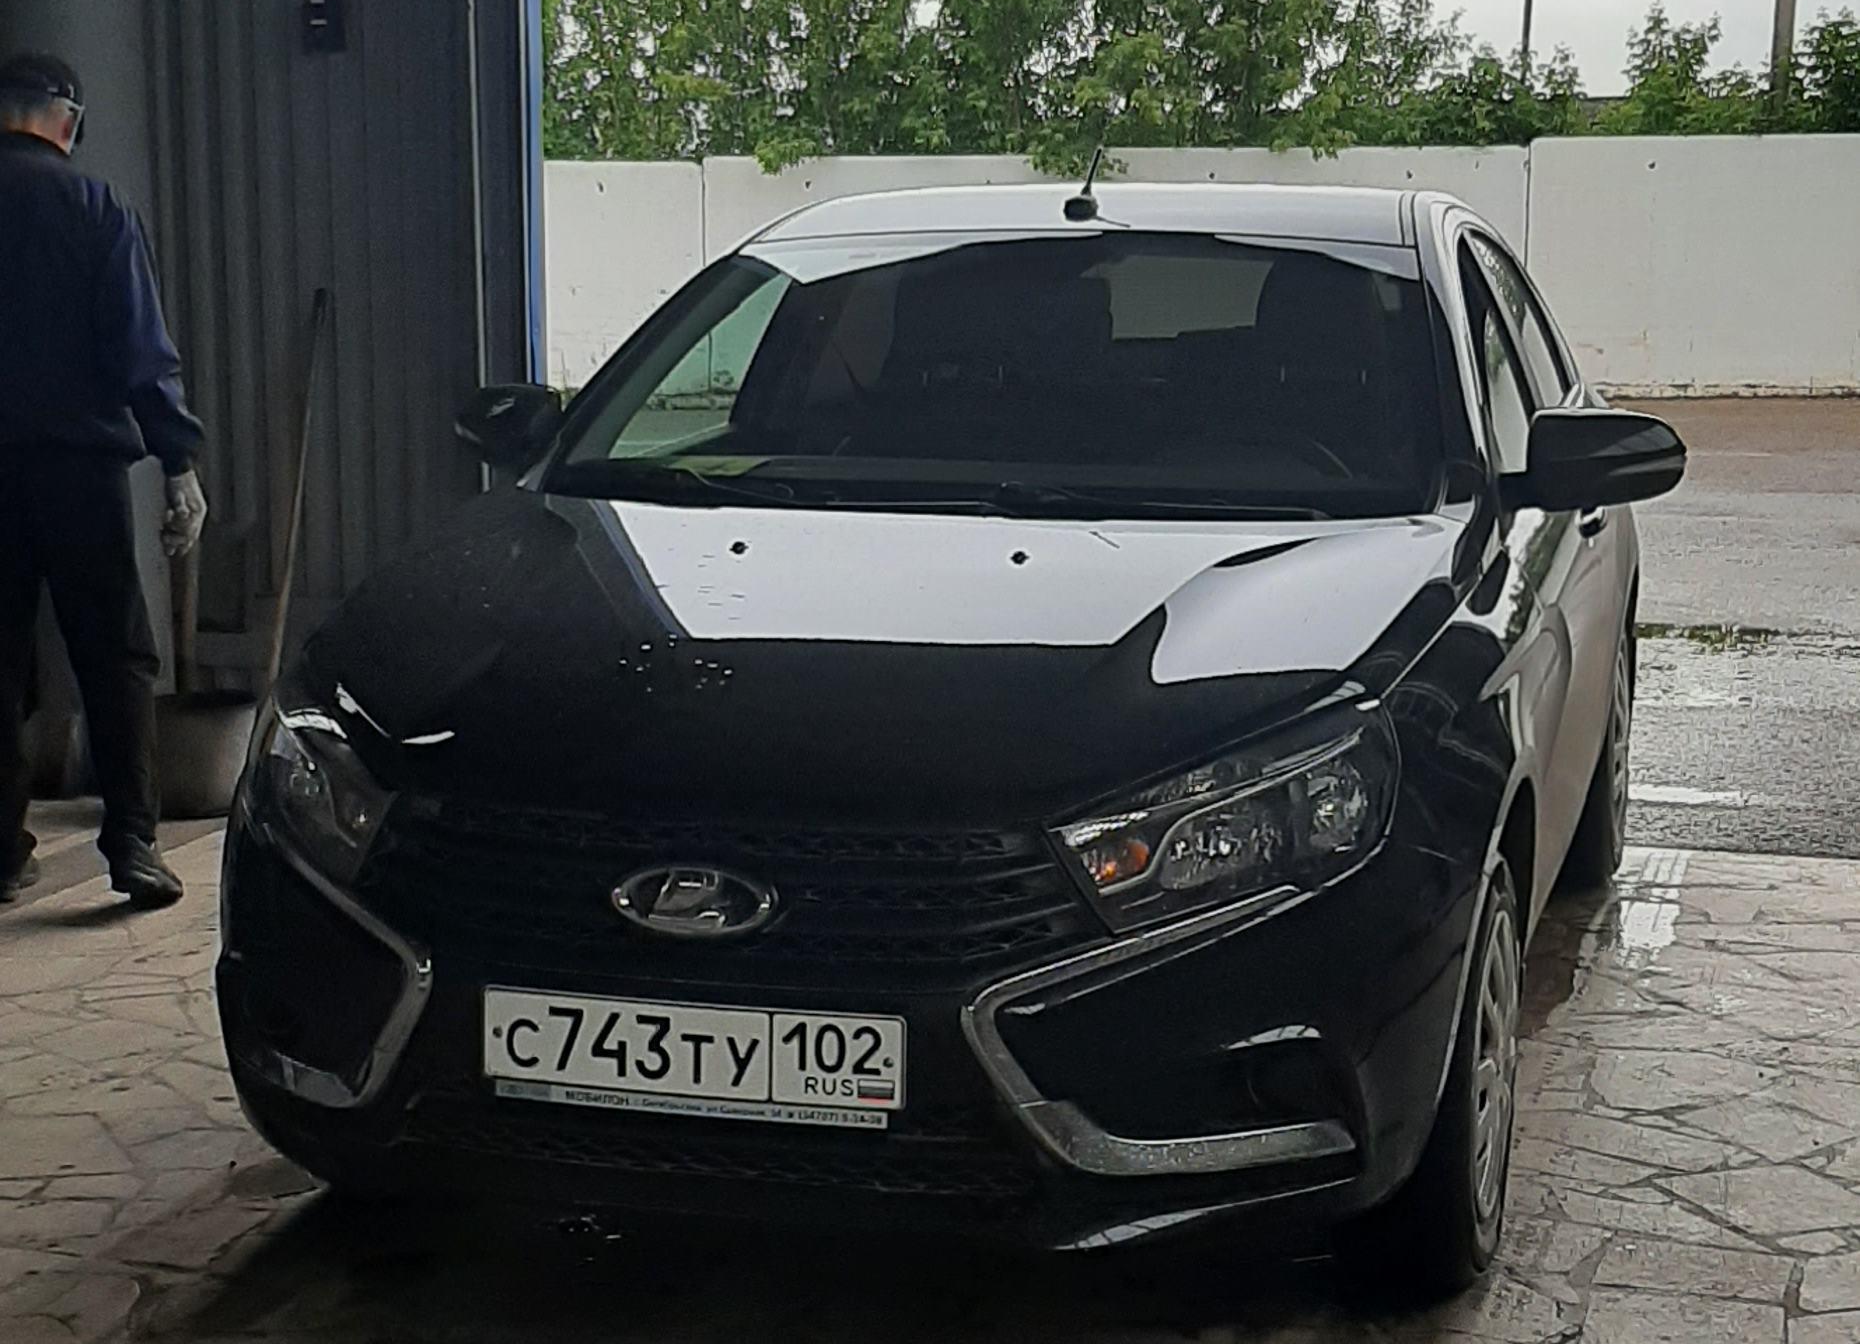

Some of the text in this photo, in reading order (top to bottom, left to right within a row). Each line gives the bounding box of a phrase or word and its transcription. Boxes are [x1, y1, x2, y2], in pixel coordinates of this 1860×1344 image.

[505, 1005, 883, 1087] С743ТУ 102
[804, 1077, 855, 1098] RUS
